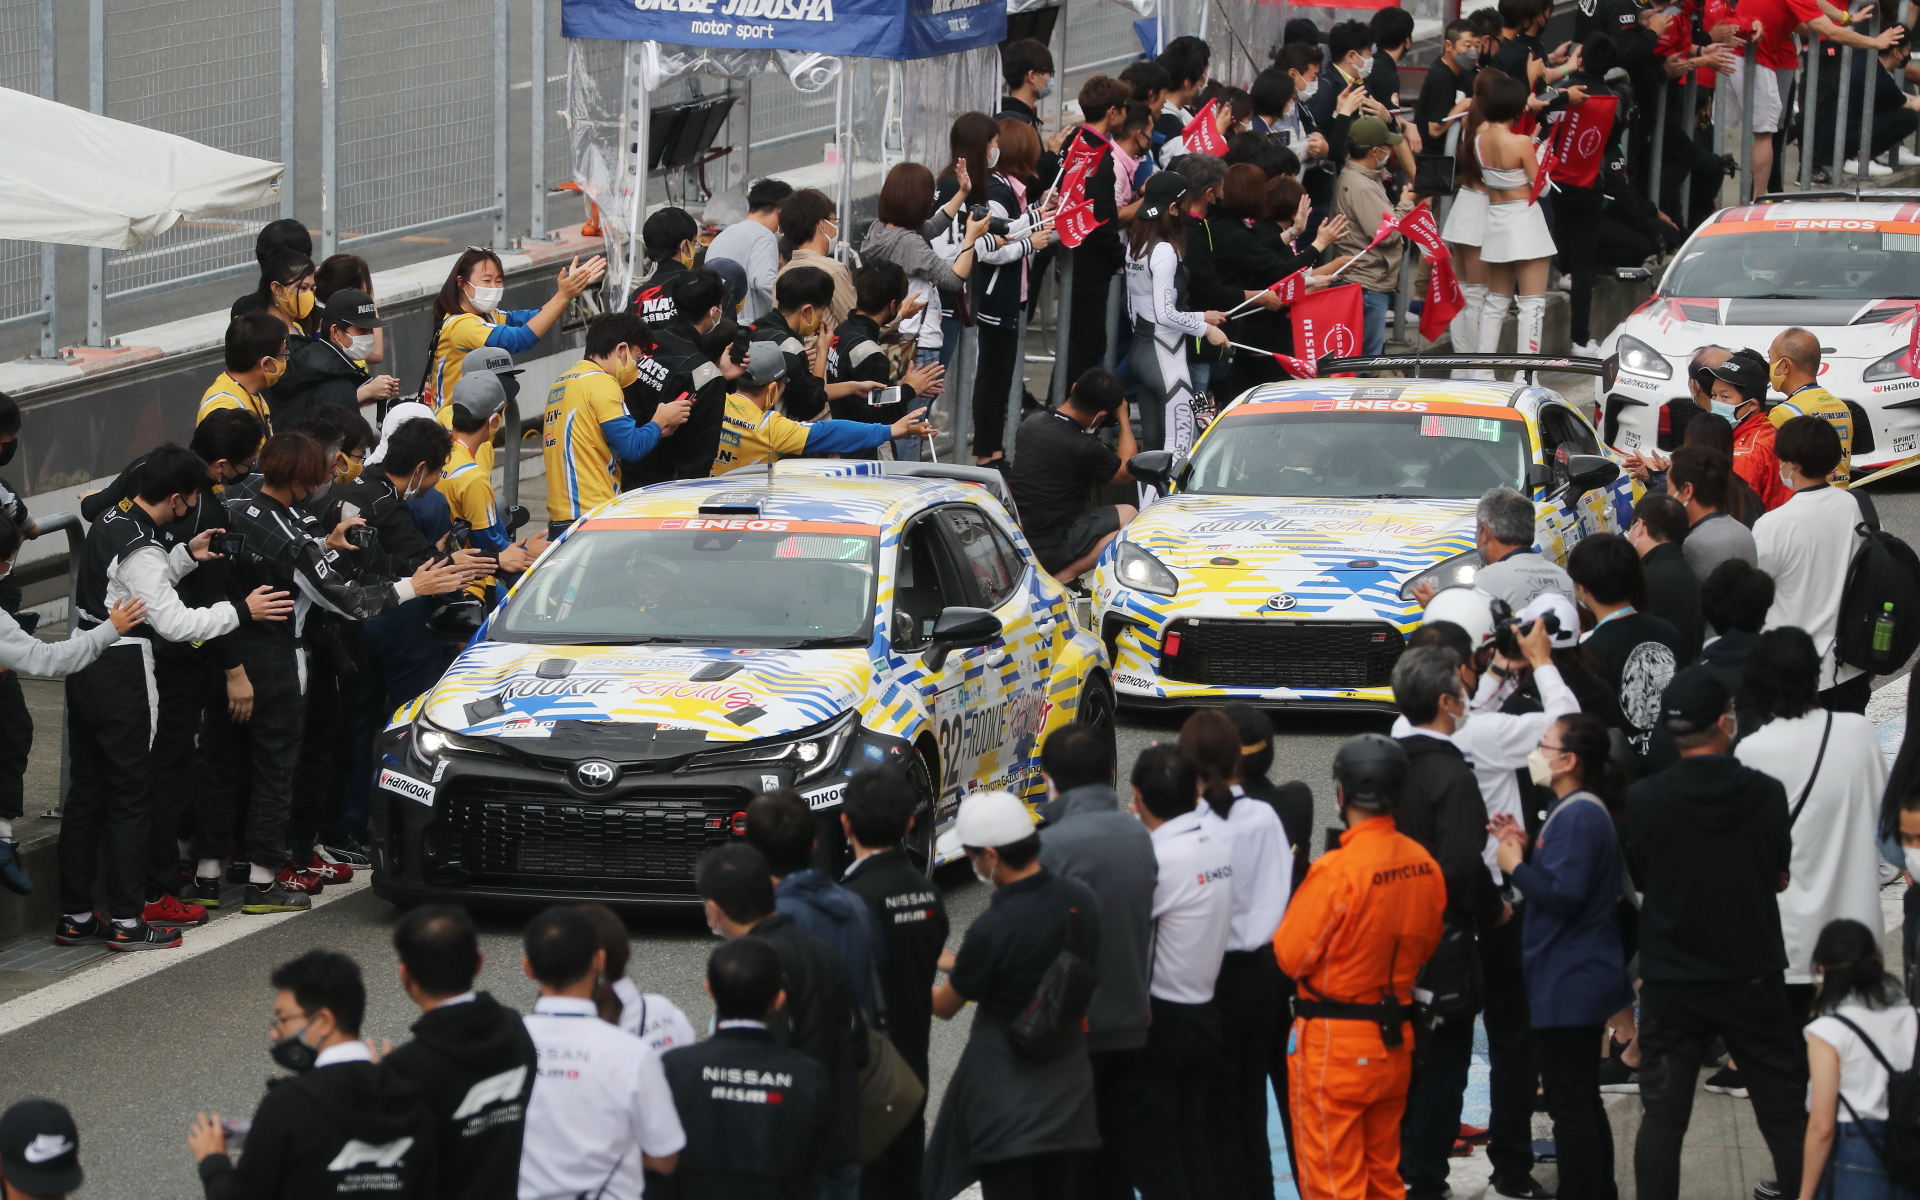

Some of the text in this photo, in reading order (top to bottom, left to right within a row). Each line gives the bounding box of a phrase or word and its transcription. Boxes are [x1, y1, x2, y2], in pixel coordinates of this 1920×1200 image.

[691, 19, 774, 40] motor sport
[1147, 206, 1158, 217] 15
[1794, 220, 1876, 230] ENEOS
[1335, 401, 1429, 412] ENEOS
[720, 432, 738, 444] LINS
[1893, 434, 1915, 445] SPIRIT
[684, 519, 789, 532] ENEOS
[1188, 519, 1438, 536] ROOKIE RACING
[501, 680, 768, 709] ROOKIE RACING
[967, 701, 1008, 761] ROOKIE
[940, 713, 963, 790] 32
[980, 780, 1002, 792] TOYOTA
[1372, 862, 1433, 885] OFFICIAL
[885, 891, 935, 908] NISSAN
[702, 1066, 793, 1088] NISSAN
